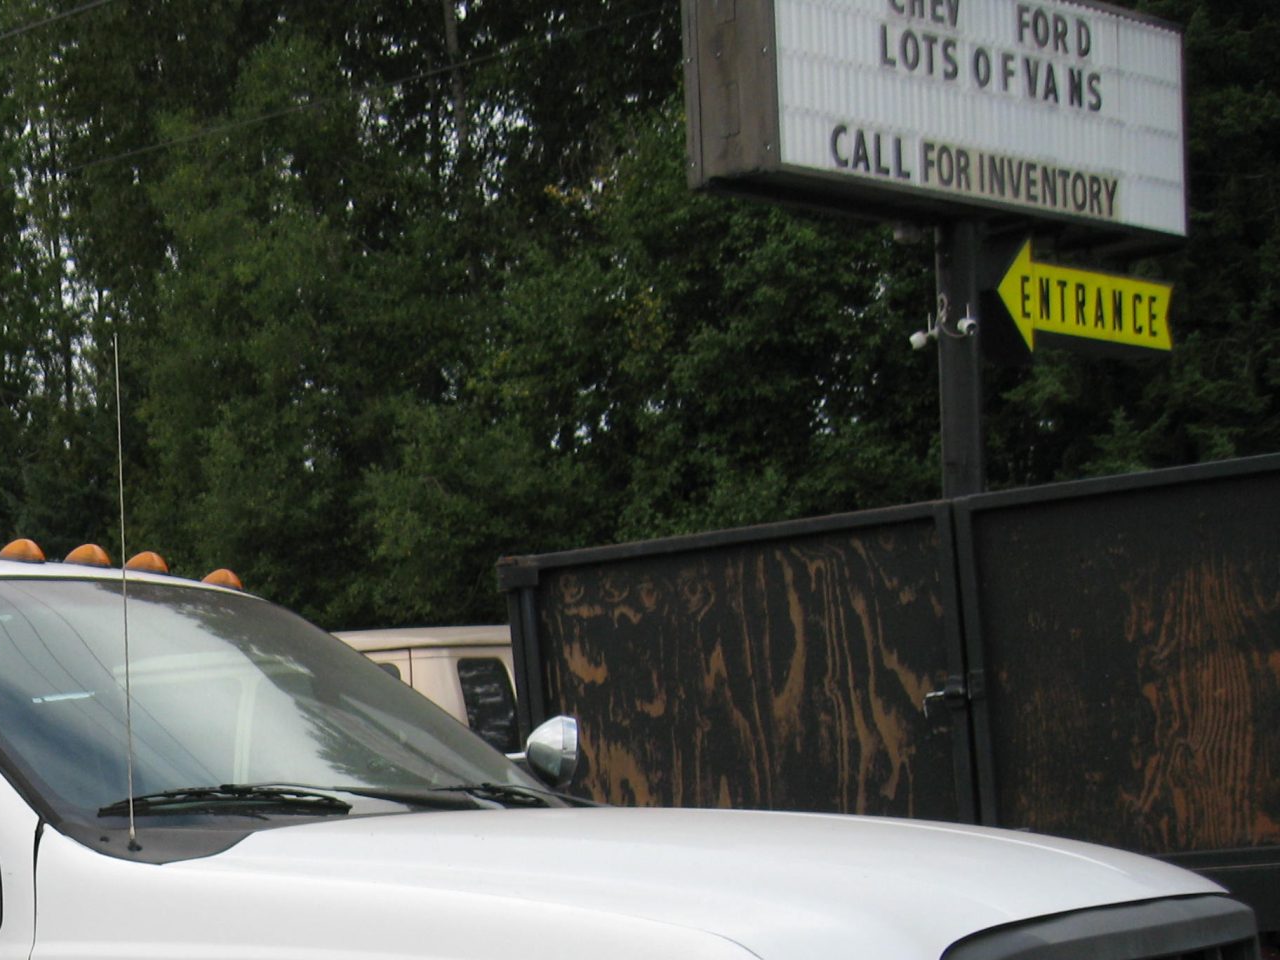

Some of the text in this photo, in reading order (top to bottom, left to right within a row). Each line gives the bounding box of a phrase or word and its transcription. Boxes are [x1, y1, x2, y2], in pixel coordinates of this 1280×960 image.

[880, 23, 1102, 113] LOTS OF VANS
[1017, 3, 1092, 58] FORD
[830, 124, 1118, 217] CALL FOR INVENTORY
[1021, 275, 1158, 338] ENTRANCE
